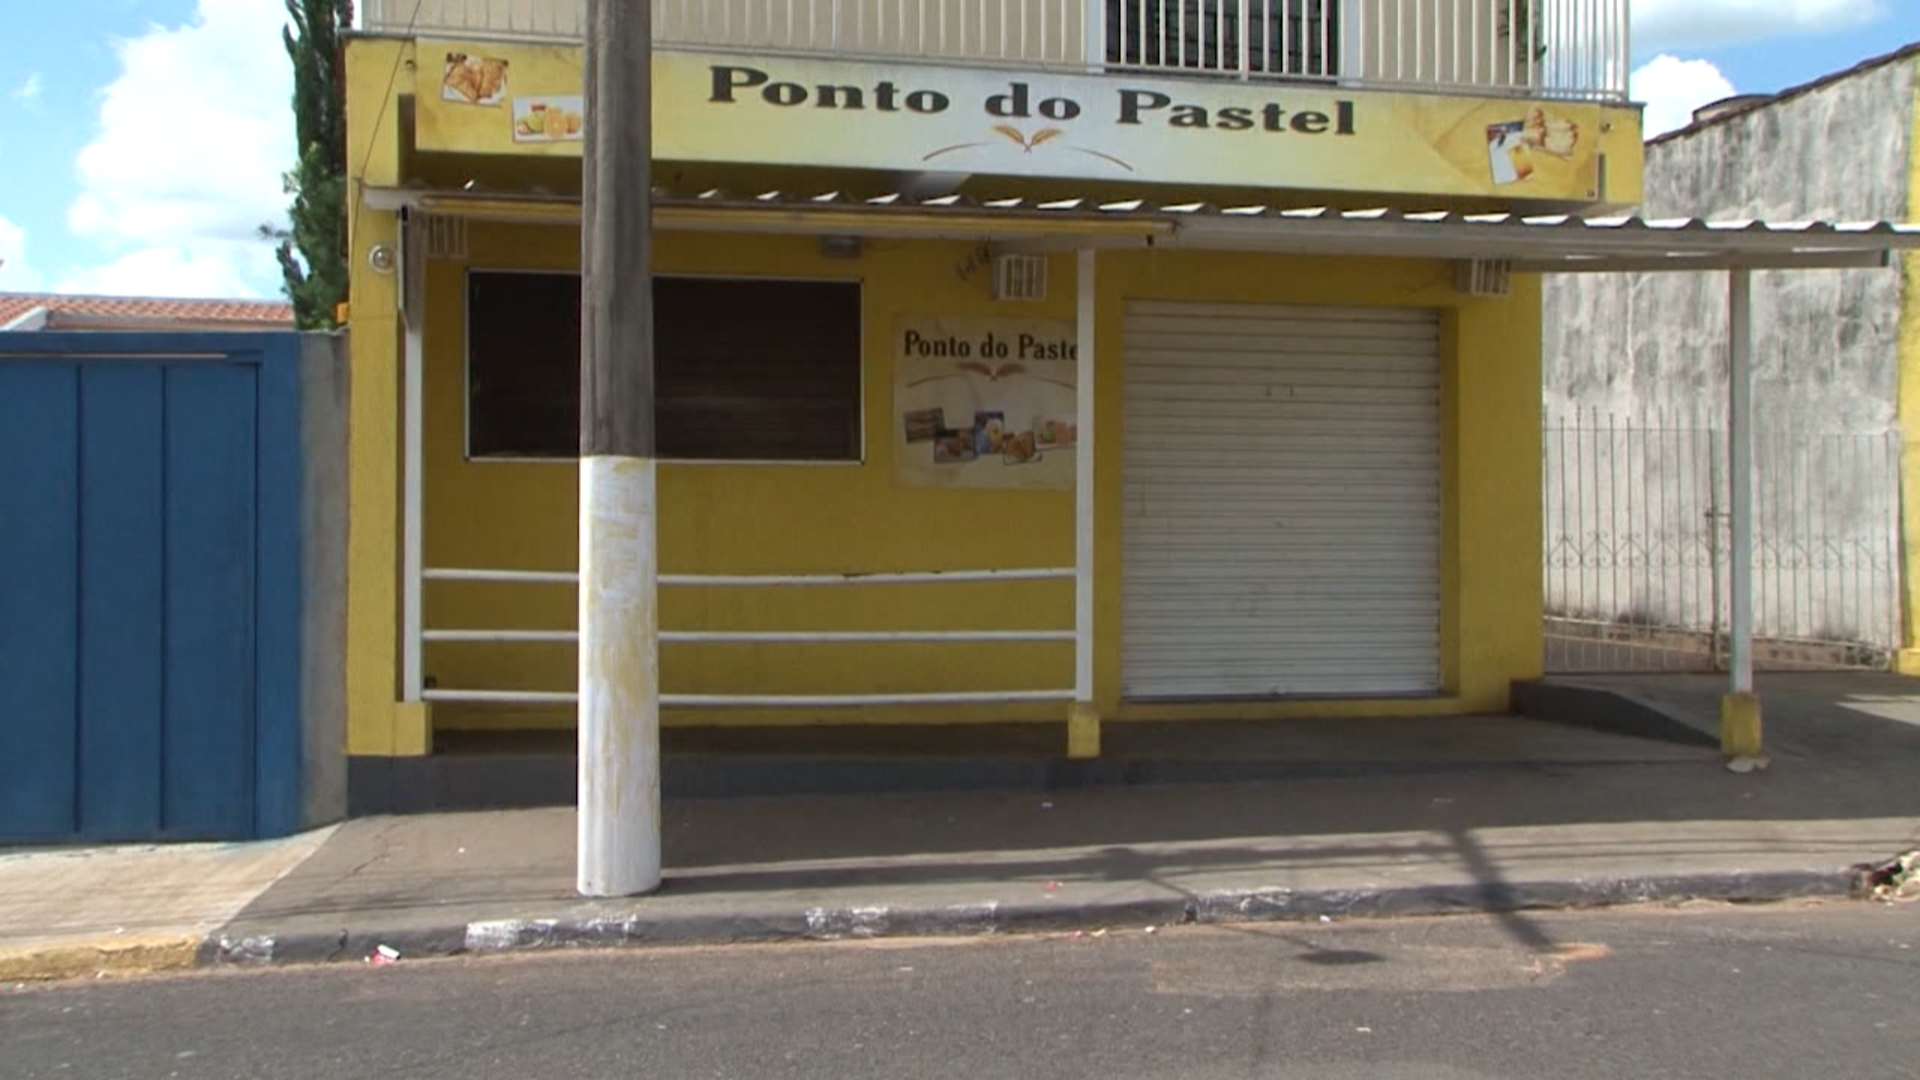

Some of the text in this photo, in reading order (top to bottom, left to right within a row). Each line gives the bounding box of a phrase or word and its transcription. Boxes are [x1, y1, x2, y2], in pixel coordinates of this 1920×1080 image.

[708, 65, 1356, 137] Ponto do Pastel
[903, 329, 1078, 361] Ponto do Paste
